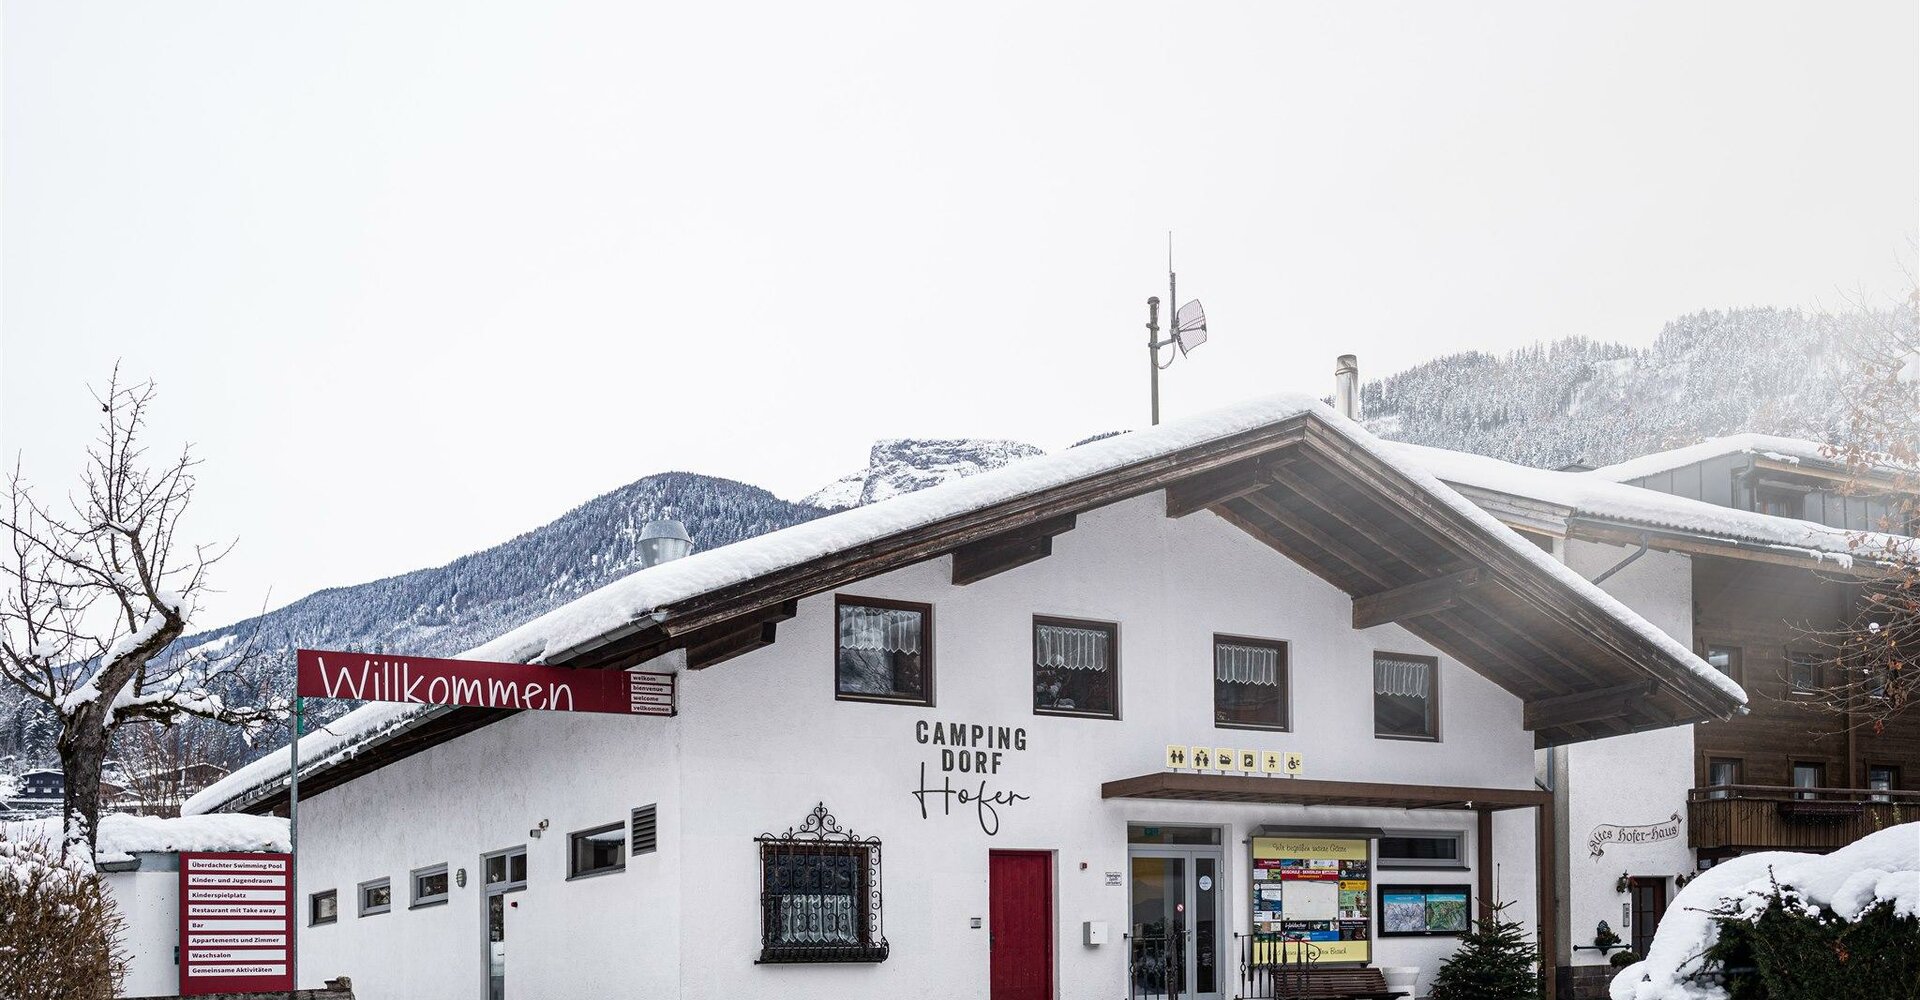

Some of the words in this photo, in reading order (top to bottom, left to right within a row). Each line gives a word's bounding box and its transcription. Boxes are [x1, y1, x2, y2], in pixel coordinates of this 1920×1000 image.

[318, 656, 573, 711] Willkommen
[916, 720, 1026, 751] CAMPING
[942, 749, 1002, 774] DORF
[912, 761, 1030, 836] Hofer
[233, 862, 267, 870] Swimming
